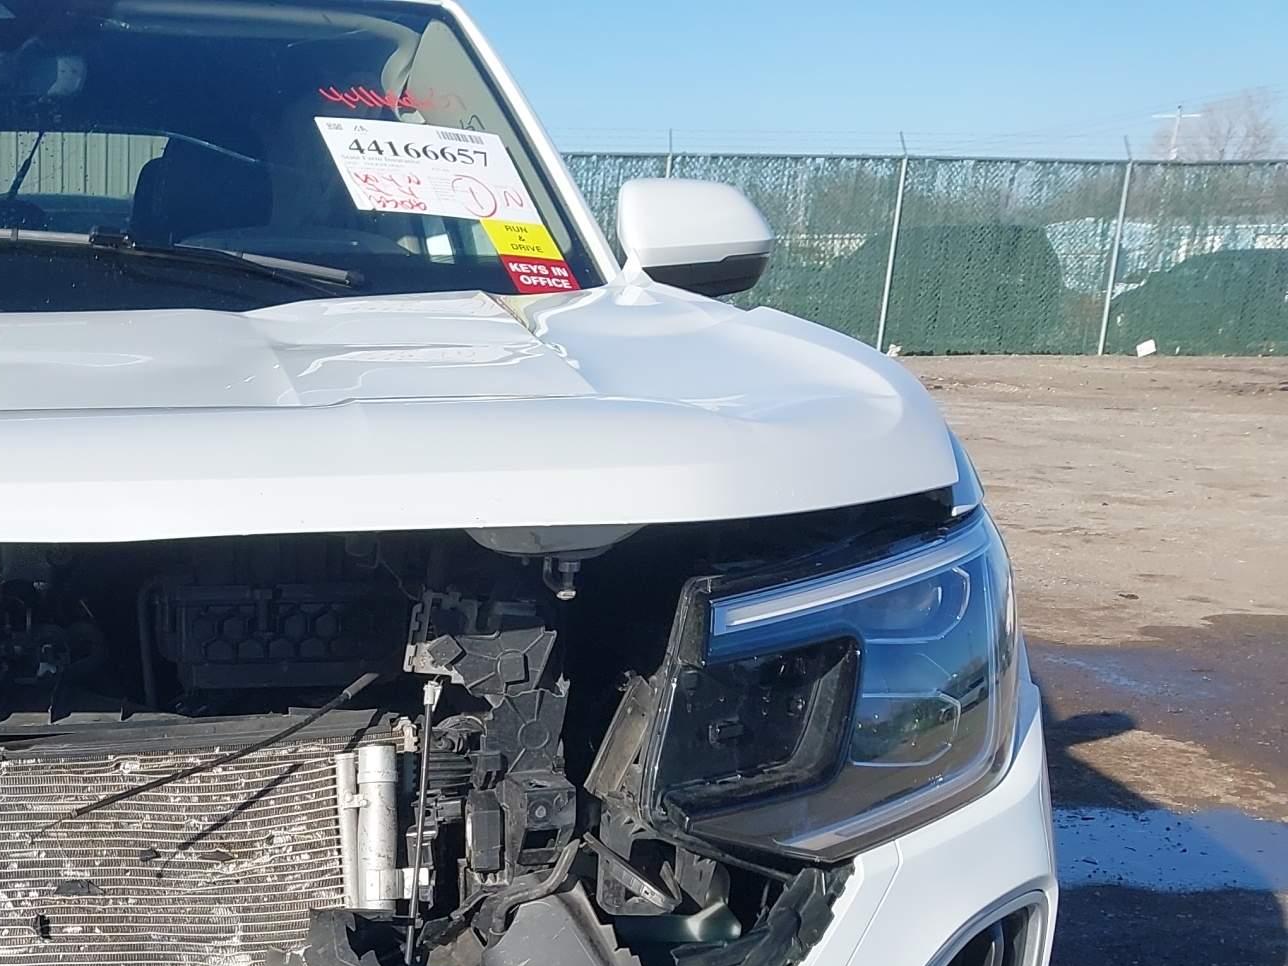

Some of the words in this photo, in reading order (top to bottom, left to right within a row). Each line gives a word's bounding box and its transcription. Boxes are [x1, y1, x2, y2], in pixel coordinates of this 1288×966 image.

[348, 138, 489, 167] 44166657
[504, 224, 529, 234] RUN
[510, 243, 545, 253] DRIVE
[508, 262, 549, 275] KEYS
[550, 266, 569, 278] IN
[519, 275, 573, 289] OFFICE
